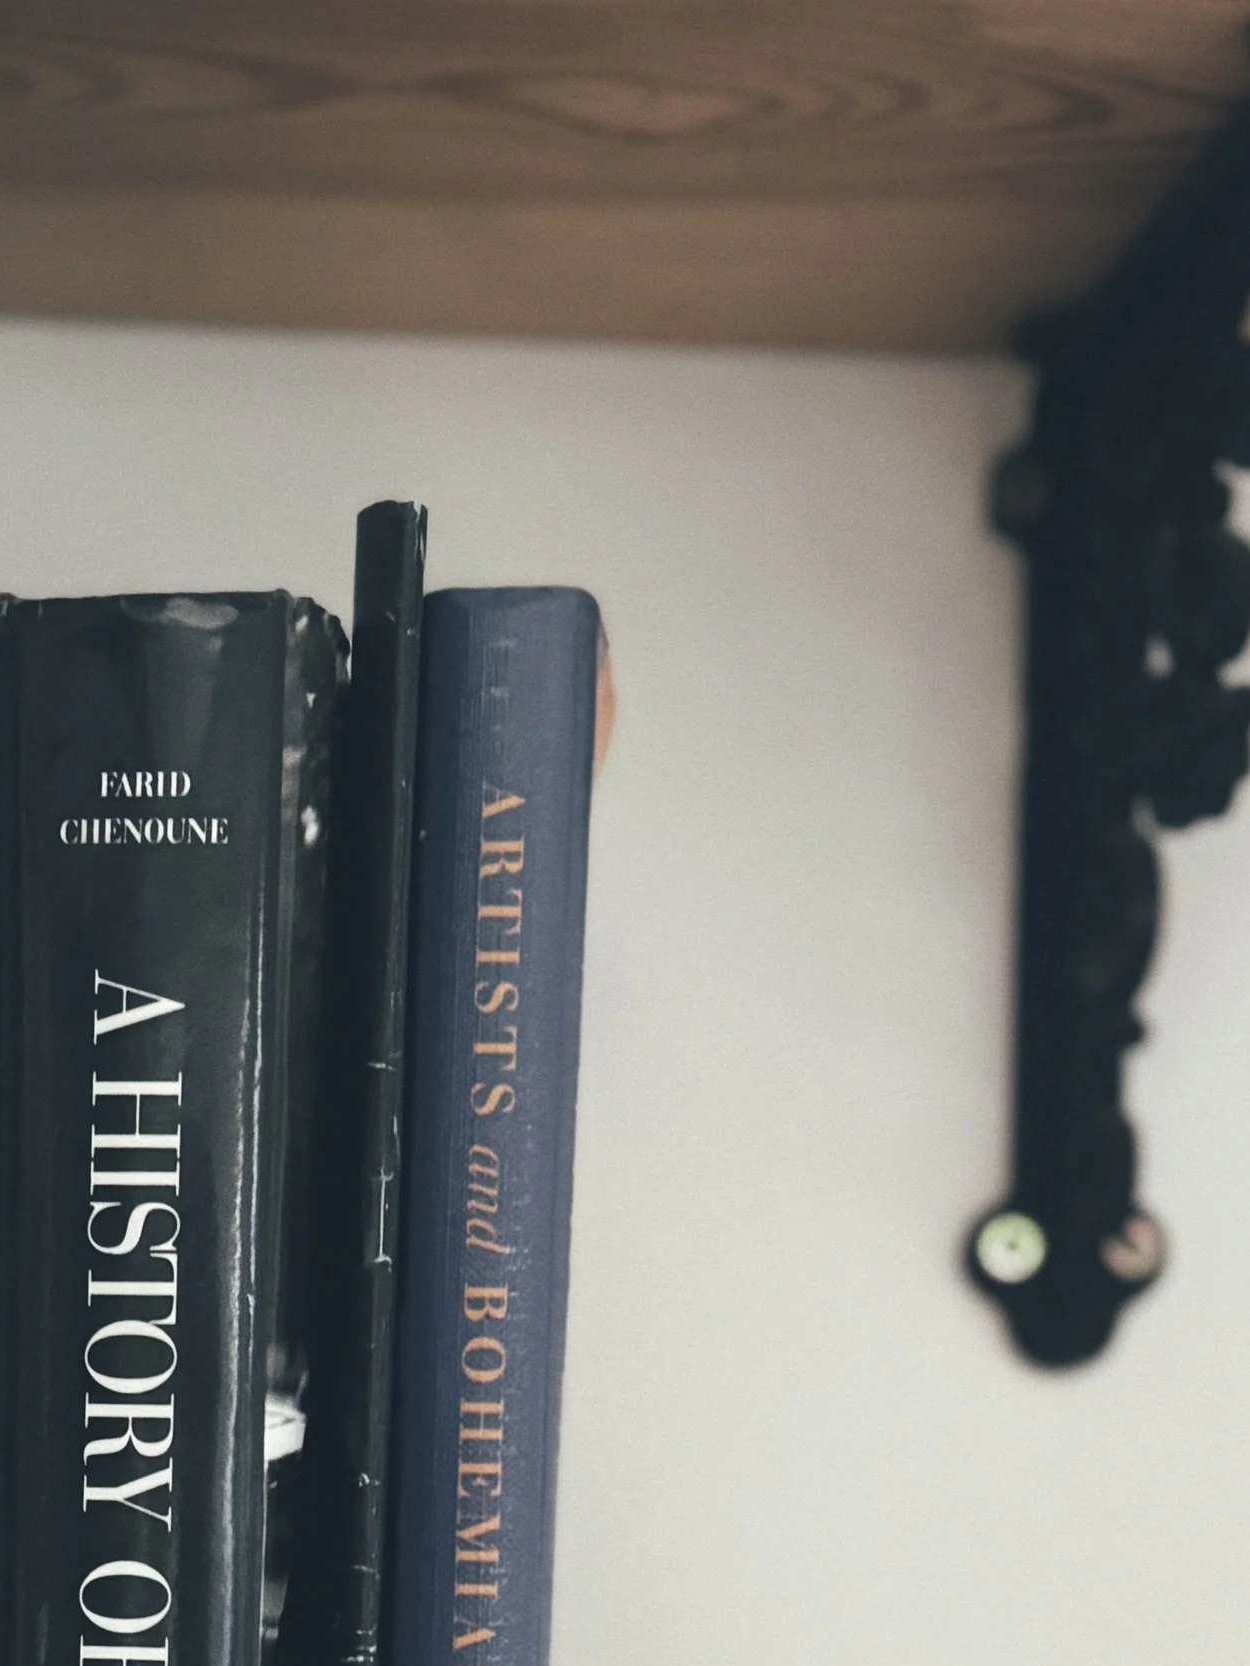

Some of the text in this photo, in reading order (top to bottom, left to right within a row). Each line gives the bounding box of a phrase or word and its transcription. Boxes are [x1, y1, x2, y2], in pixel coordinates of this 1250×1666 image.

[58, 817, 229, 846] CHENOUNE
[99, 770, 192, 799] FARID
[469, 780, 527, 1120] ARTISTS
[92, 968, 187, 1046] A
[464, 1145, 512, 1255] and
[81, 1070, 184, 1533] HISTORY
